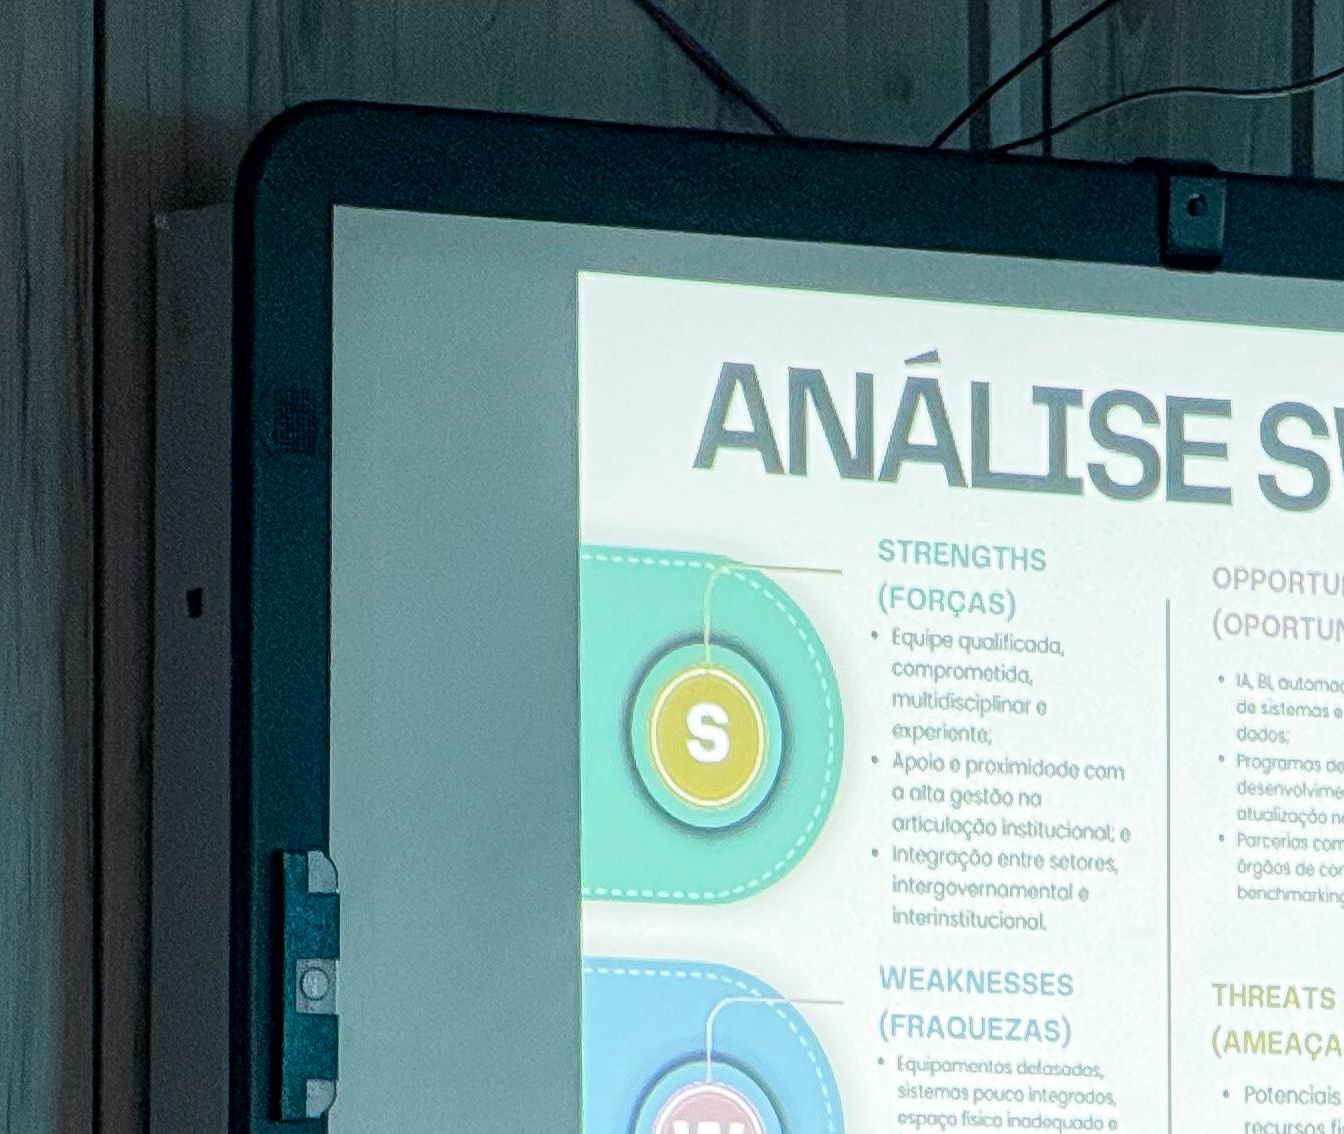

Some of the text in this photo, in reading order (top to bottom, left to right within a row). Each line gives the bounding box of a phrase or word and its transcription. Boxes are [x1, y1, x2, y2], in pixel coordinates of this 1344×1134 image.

[691, 347, 1234, 506] ANÁLISE
[877, 538, 1047, 572] STRENGTHS
[878, 582, 1016, 622] (FORÇAS)
[892, 627, 1065, 657] Equipe qualificada,
[892, 661, 1033, 686] comprometida,
[892, 691, 1047, 717] multidisciplinar e
[1236, 699, 1257, 715] de
[1261, 701, 1329, 718] sistemas
[1334, 707, 1342, 718] e
[686, 702, 730, 763] S
[892, 752, 1125, 781] Apoio e proximidade com
[1236, 753, 1321, 775] Programas
[1326, 759, 1344, 774] de
[892, 784, 1041, 809] a alta gestão na
[892, 815, 997, 841] articulação
[1120, 827, 1131, 843] e
[1237, 806, 1327, 828] atualização
[1237, 832, 1308, 850] Parcerias
[892, 845, 1118, 874] Integração entre setores,
[1237, 859, 1291, 879] órgãos
[1295, 861, 1315, 877] de
[892, 875, 1089, 902] intergovernamental e
[892, 906, 1047, 931] interinstitucional.
[879, 964, 1074, 996] WEAKNESSES
[1212, 982, 1336, 1010] THREATS
[878, 1009, 1072, 1048] (FRAQUEZAS)
[897, 1055, 1104, 1079] Equipamentos defasados,
[897, 1081, 1117, 1109] sistemas pouco integrados,
[1244, 1084, 1341, 1106] Potenciais
[897, 1112, 957, 1131] espaço
[961, 1110, 1002, 1127] físico
[1108, 1118, 1117, 1130] e
